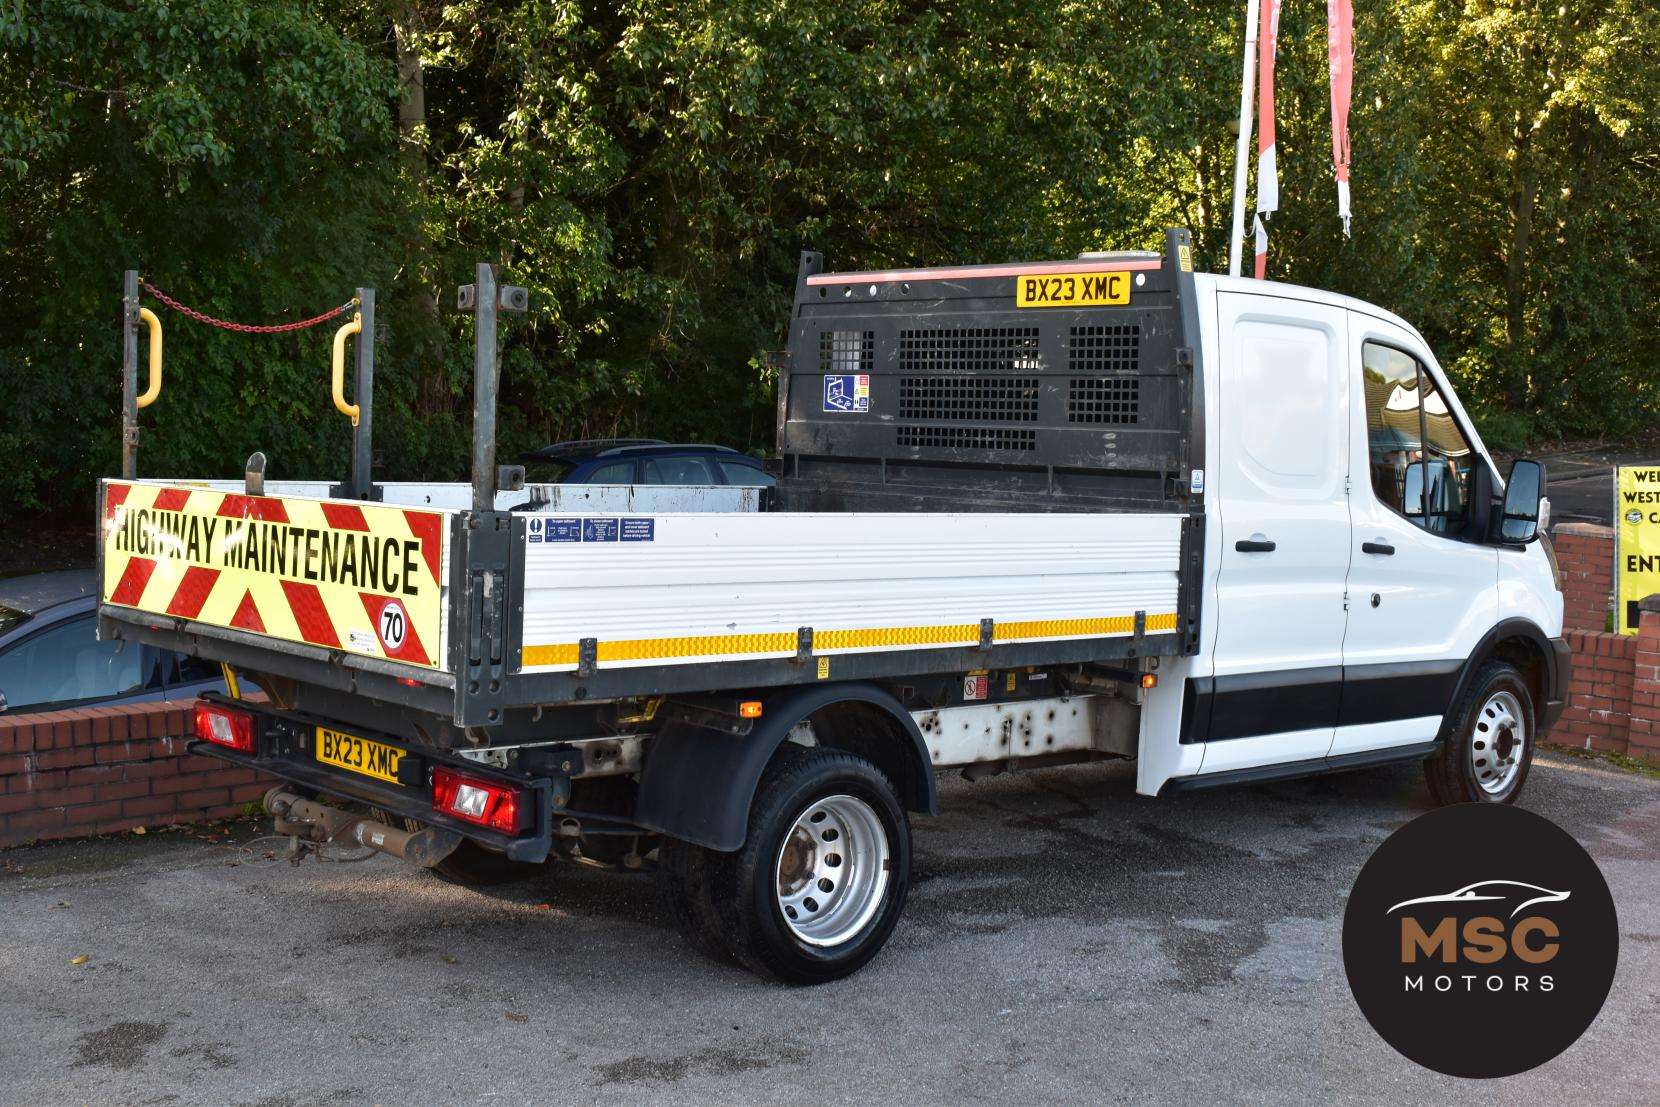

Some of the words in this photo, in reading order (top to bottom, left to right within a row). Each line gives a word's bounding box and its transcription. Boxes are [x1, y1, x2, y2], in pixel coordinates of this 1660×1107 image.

[1025, 278, 1075, 302] BX23
[1081, 276, 1121, 300] XMC
[1648, 511, 1660, 524] C
[115, 507, 218, 564] HIGHWAY
[223, 519, 420, 596] MAINTENANCE
[384, 611, 402, 643] 70
[323, 731, 363, 768] BX23
[367, 742, 399, 778] XMC
